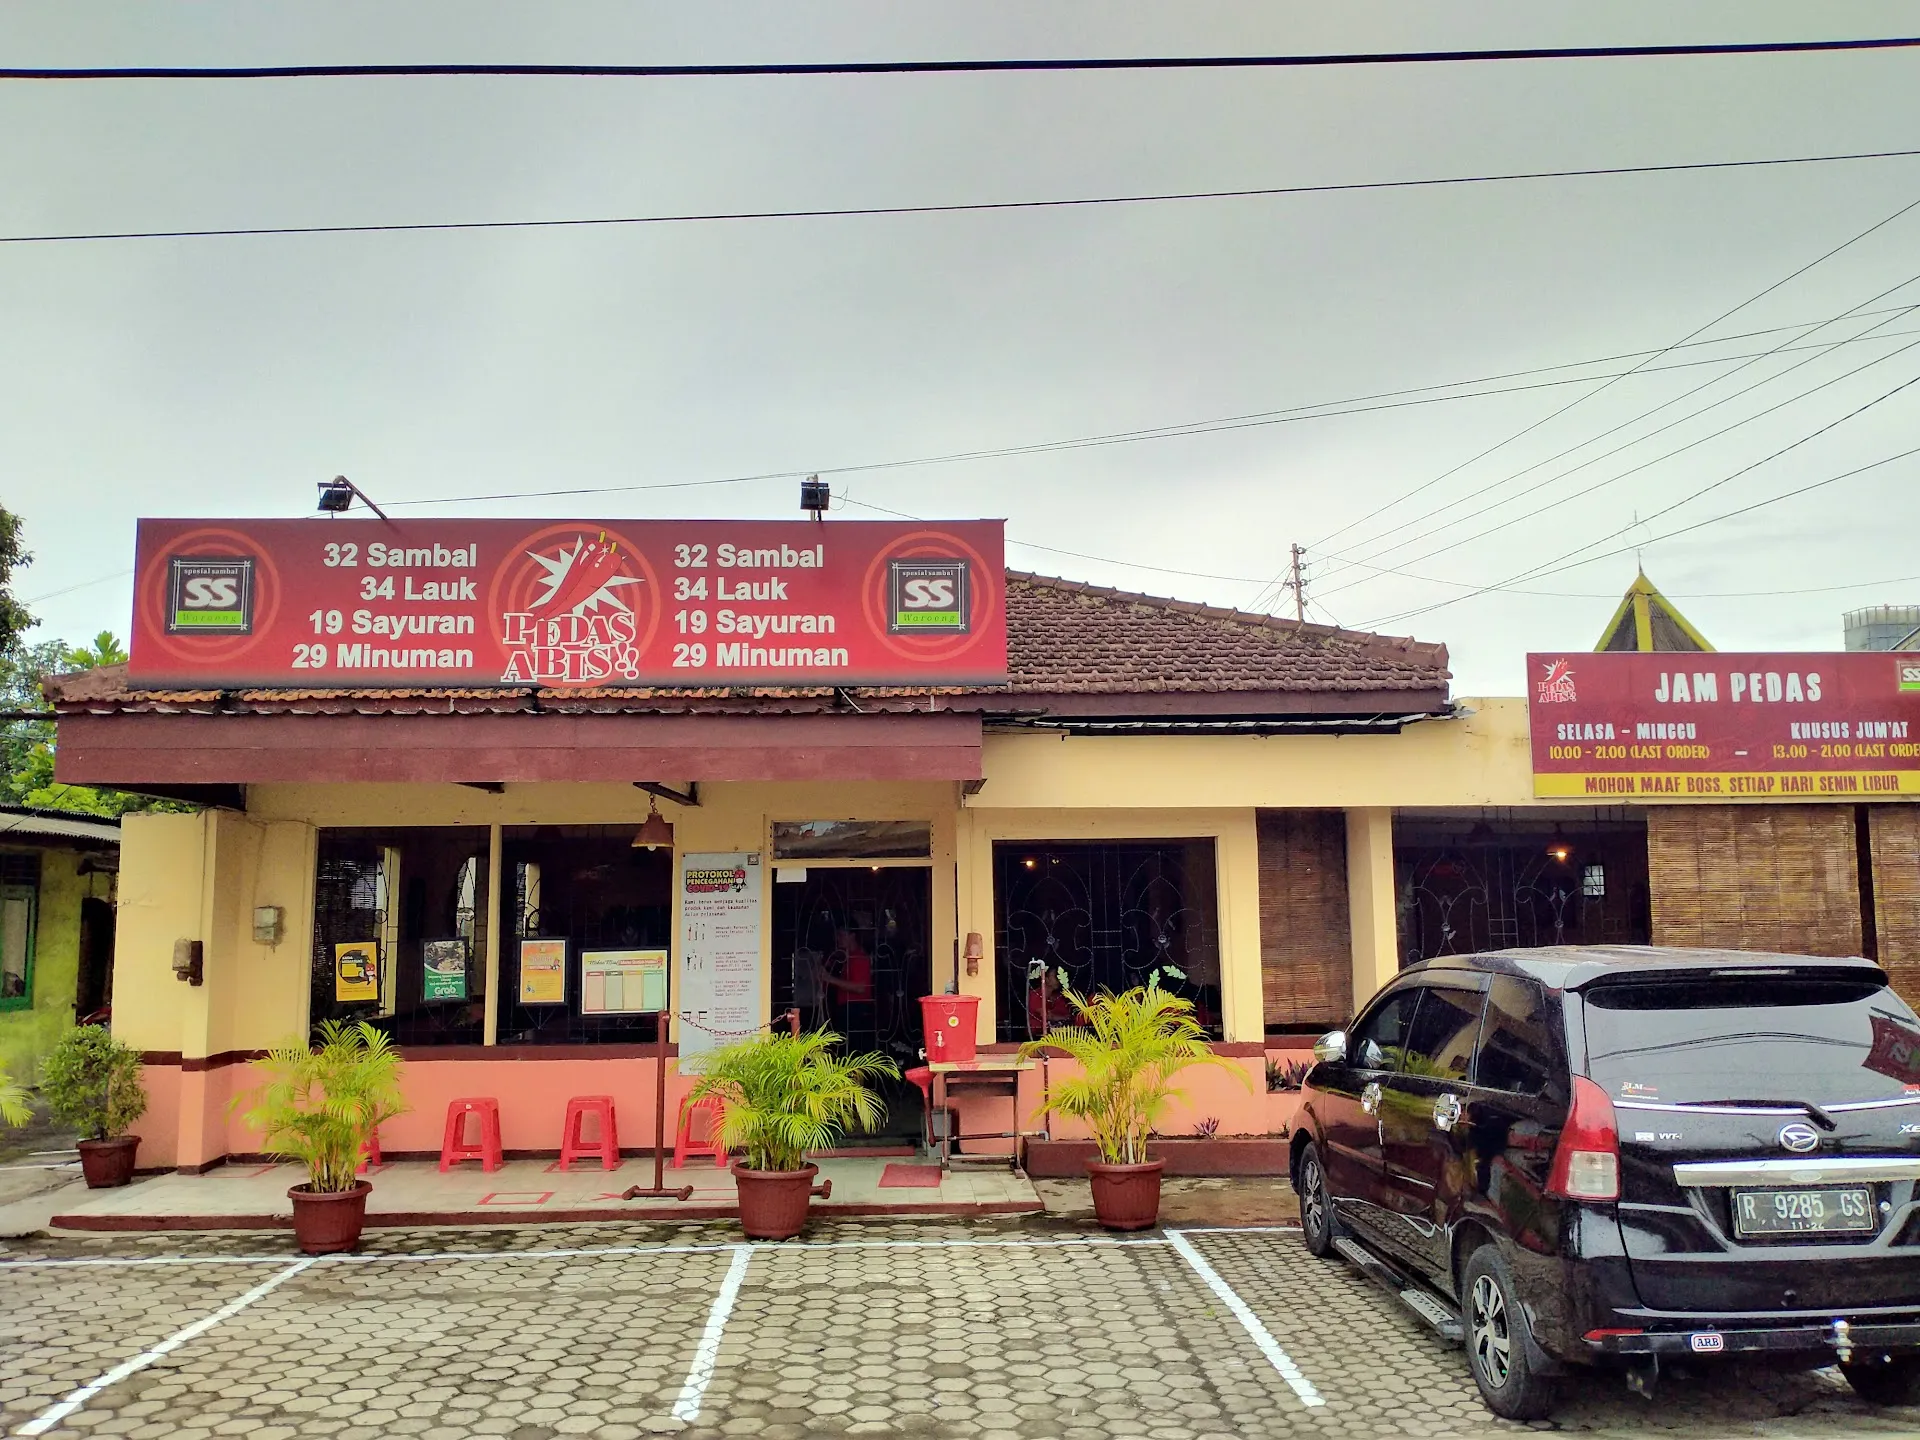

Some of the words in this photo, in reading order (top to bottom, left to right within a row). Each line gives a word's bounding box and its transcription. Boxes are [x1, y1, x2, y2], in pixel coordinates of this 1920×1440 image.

[323, 543, 358, 568] 32
[367, 543, 477, 568] Sambal
[674, 544, 708, 569] 32
[716, 544, 824, 569] Sambal
[184, 577, 237, 607] SS
[360, 576, 394, 601] 34
[404, 576, 477, 601] Lauk
[674, 577, 708, 601] 34
[718, 577, 788, 601] Lauk
[904, 579, 954, 608] SS
[308, 610, 342, 634] 19
[352, 609, 475, 640] Sayuran
[503, 611, 636, 648] PEDAS
[674, 610, 707, 634] 19
[715, 609, 835, 639] Sayuran
[903, 613, 956, 623] Waroeng
[292, 643, 328, 669] 29
[337, 643, 474, 668] Minuman
[501, 643, 640, 682] ABIS!!
[672, 643, 707, 667] 29
[716, 642, 849, 667] Minuman
[1654, 672, 1718, 702] JAM
[1730, 672, 1822, 703] PEDAS
[1557, 723, 1615, 741] SELASA
[1636, 722, 1697, 740] MINGGU
[1790, 722, 1850, 740] KHUSUS
[1856, 721, 1909, 739] JUM'AT
[1549, 745, 1581, 760] 10.00
[1595, 745, 1626, 759] 21.00
[1630, 745, 1662, 760] (LAST
[1667, 744, 1710, 760] ORDER)
[1773, 744, 1807, 759] 13.00
[1820, 744, 1851, 758] 21.00
[1855, 743, 1886, 758] (LAST
[1585, 777, 1636, 794] MOHON
[1641, 776, 1681, 793] MAAF
[1687, 776, 1724, 795] BOSS,
[1729, 775, 1775, 793] SETIAP
[1781, 776, 1814, 792] HARI
[1819, 775, 1858, 792] SENIN
[1862, 775, 1900, 791] LIBUR
[686, 870, 734, 879] PROTOKOL
[686, 885, 729, 893] COVID-19
[434, 985, 456, 995] Grab
[1742, 1195, 1757, 1220] R
[1774, 1193, 1825, 1219] 9285
[1840, 1192, 1865, 1217] GS
[1696, 1337, 1719, 1348] ARB
